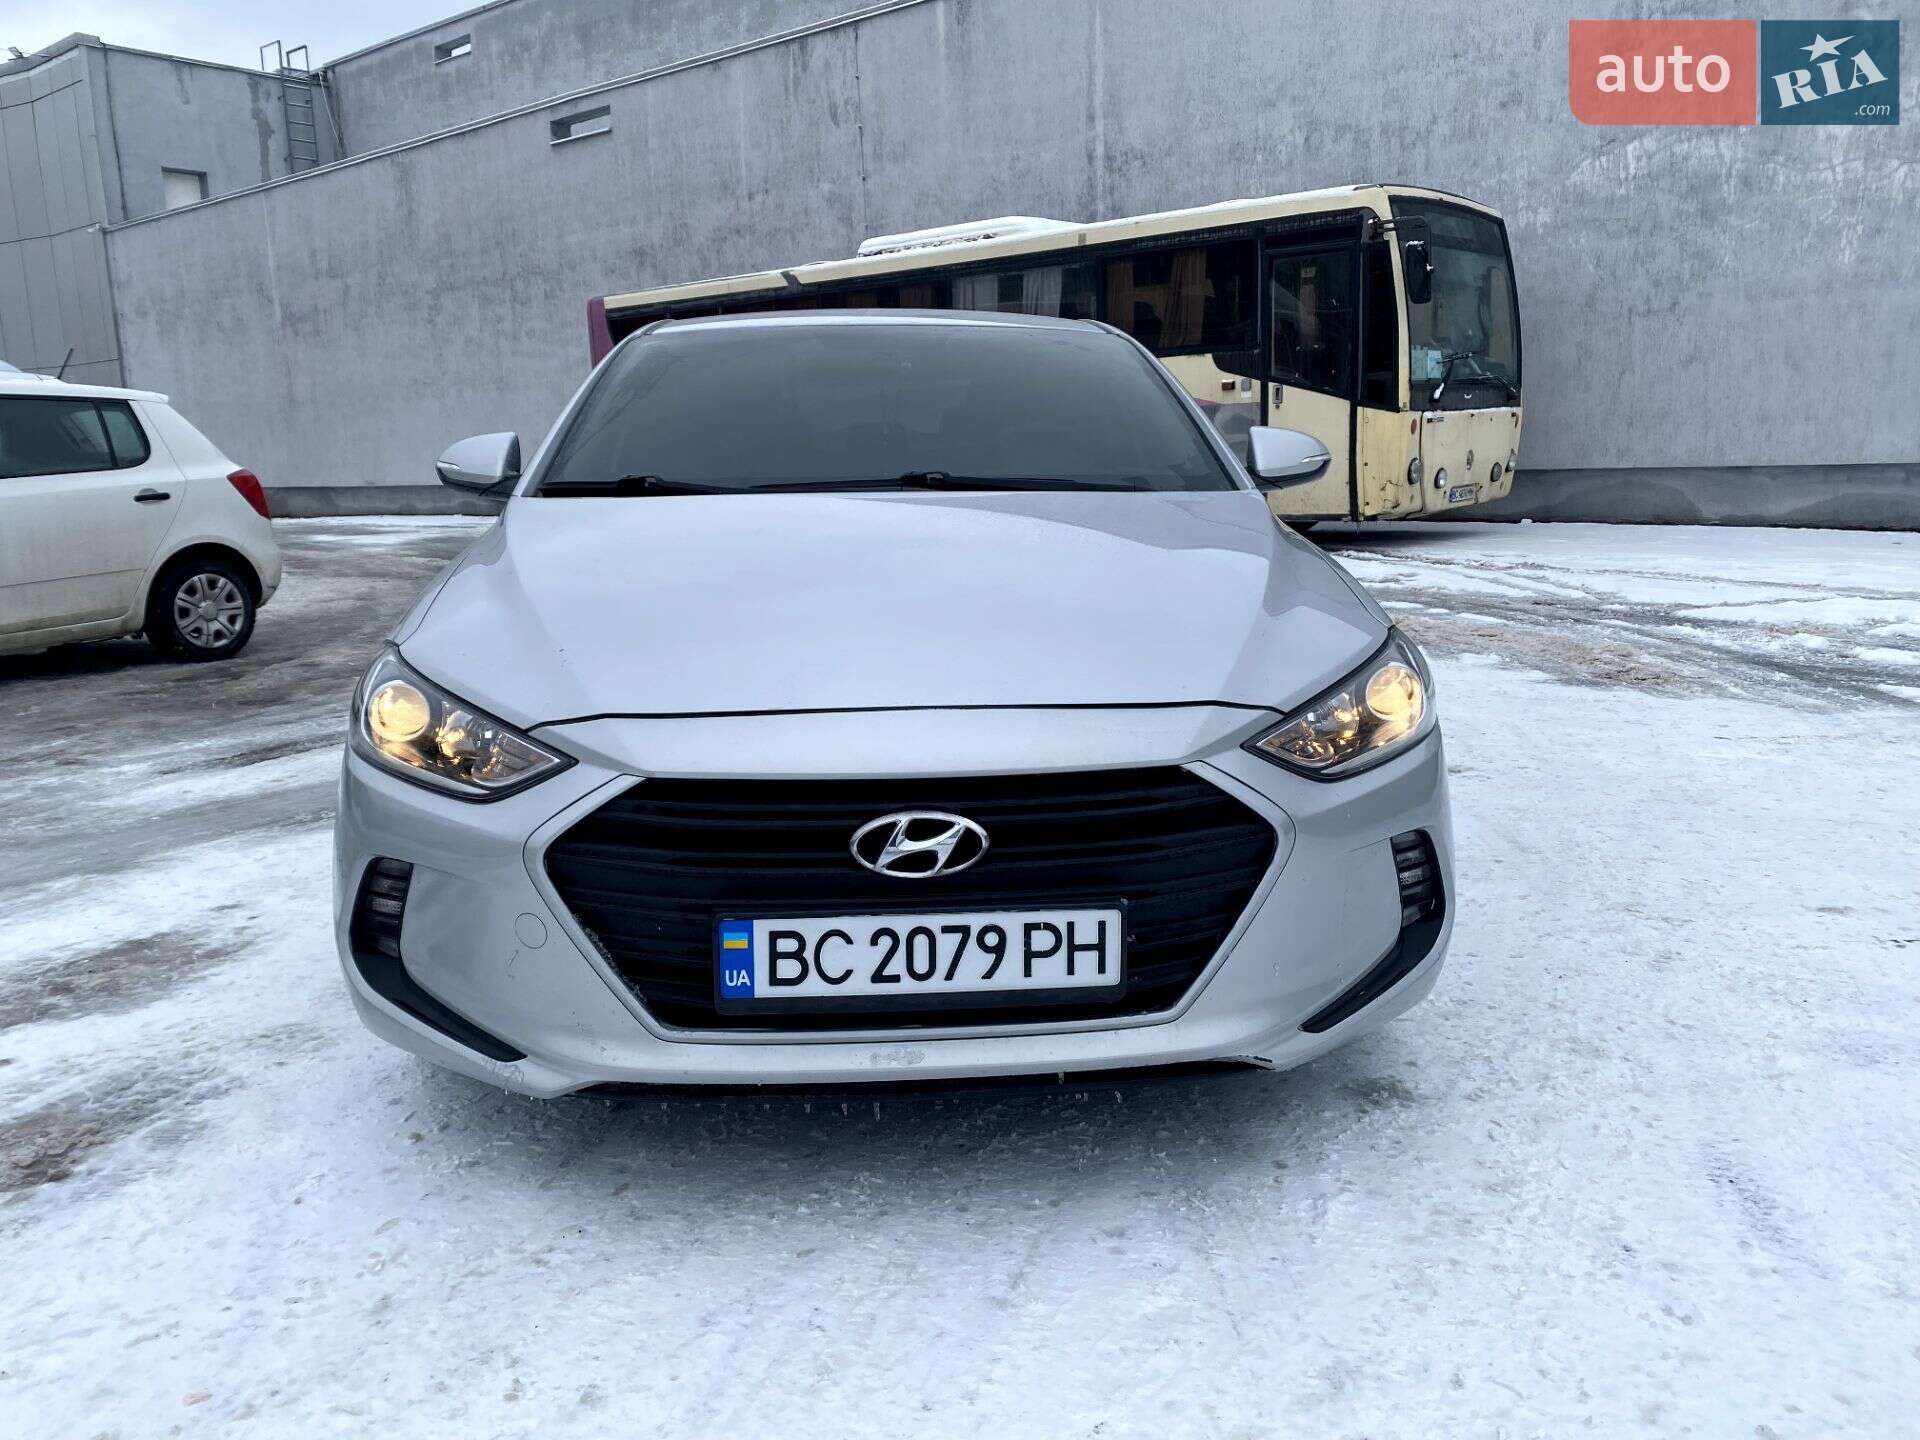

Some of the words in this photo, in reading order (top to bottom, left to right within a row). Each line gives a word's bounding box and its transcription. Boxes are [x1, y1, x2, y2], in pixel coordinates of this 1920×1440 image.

[769, 929, 854, 987] BC
[870, 924, 1007, 984] 2079
[1023, 919, 1107, 978] PH
[725, 970, 751, 986] UA
